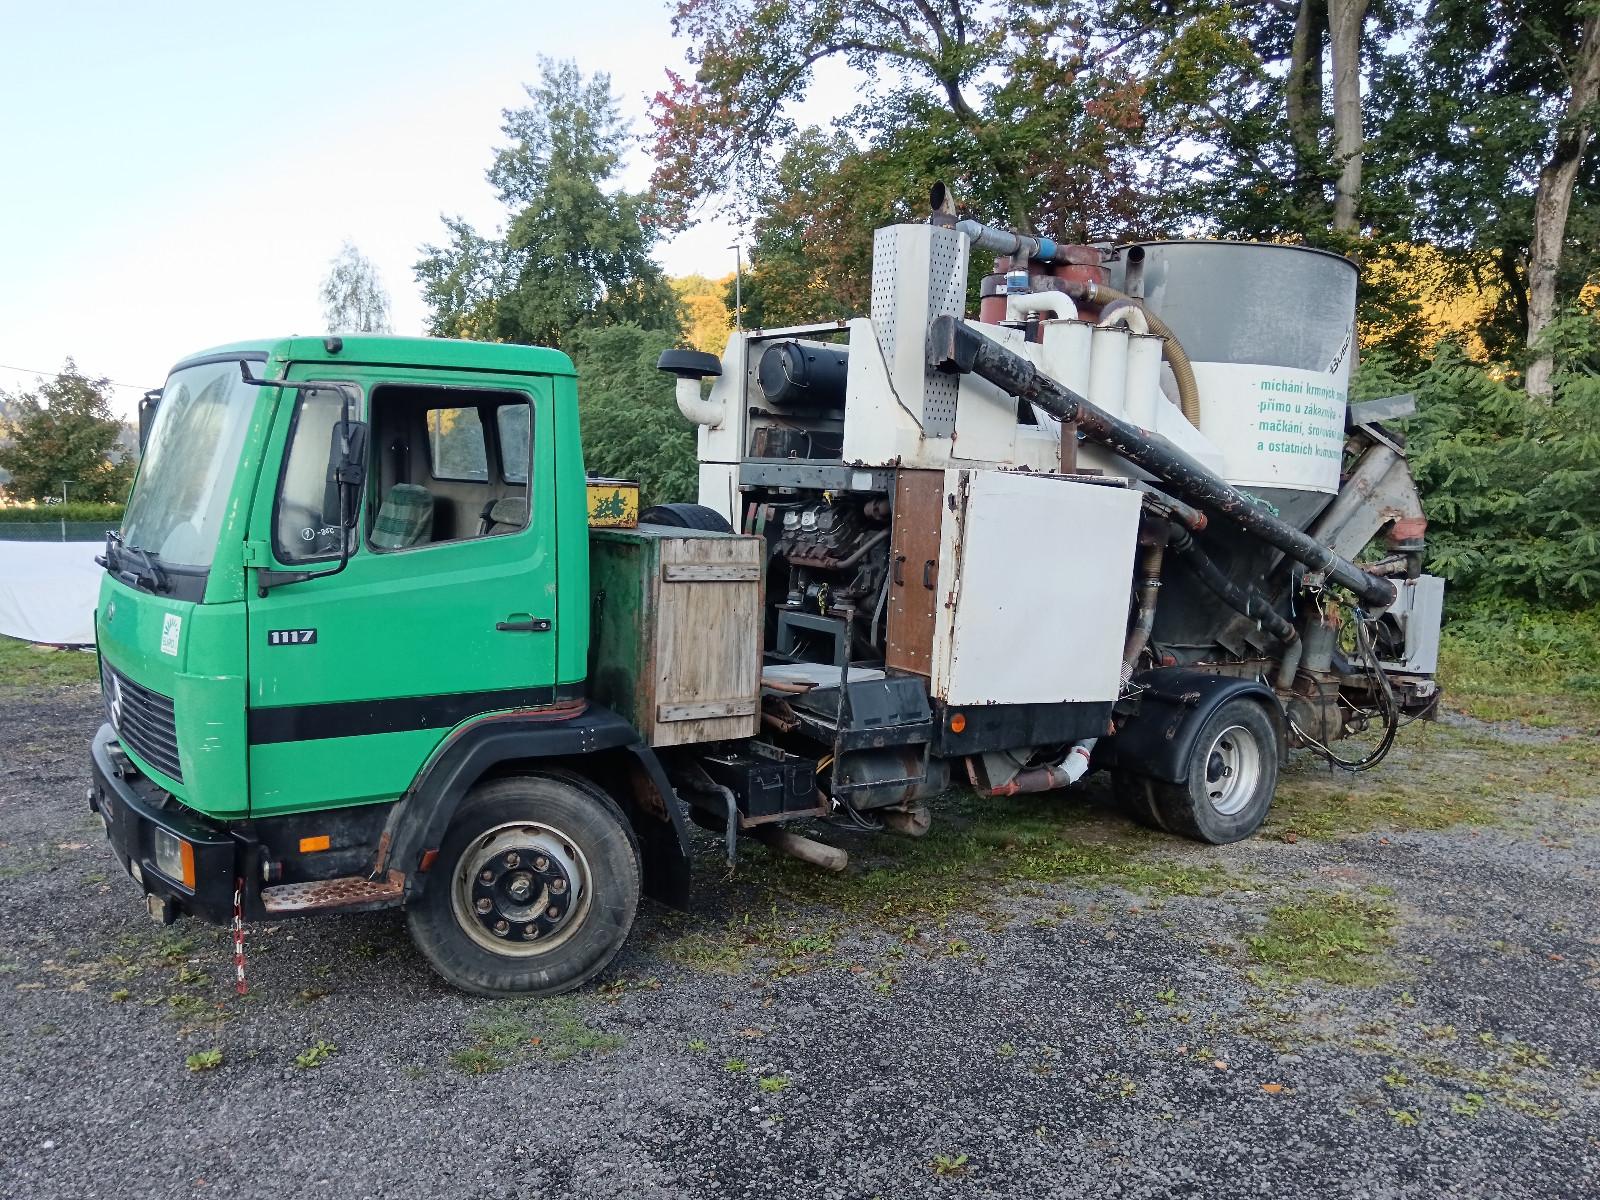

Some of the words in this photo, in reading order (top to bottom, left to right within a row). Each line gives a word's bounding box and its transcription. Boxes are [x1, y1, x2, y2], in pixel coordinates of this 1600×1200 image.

[1295, 405, 1301, 414] u
[1257, 441, 1264, 451] a
[271, 630, 314, 644] 1117
